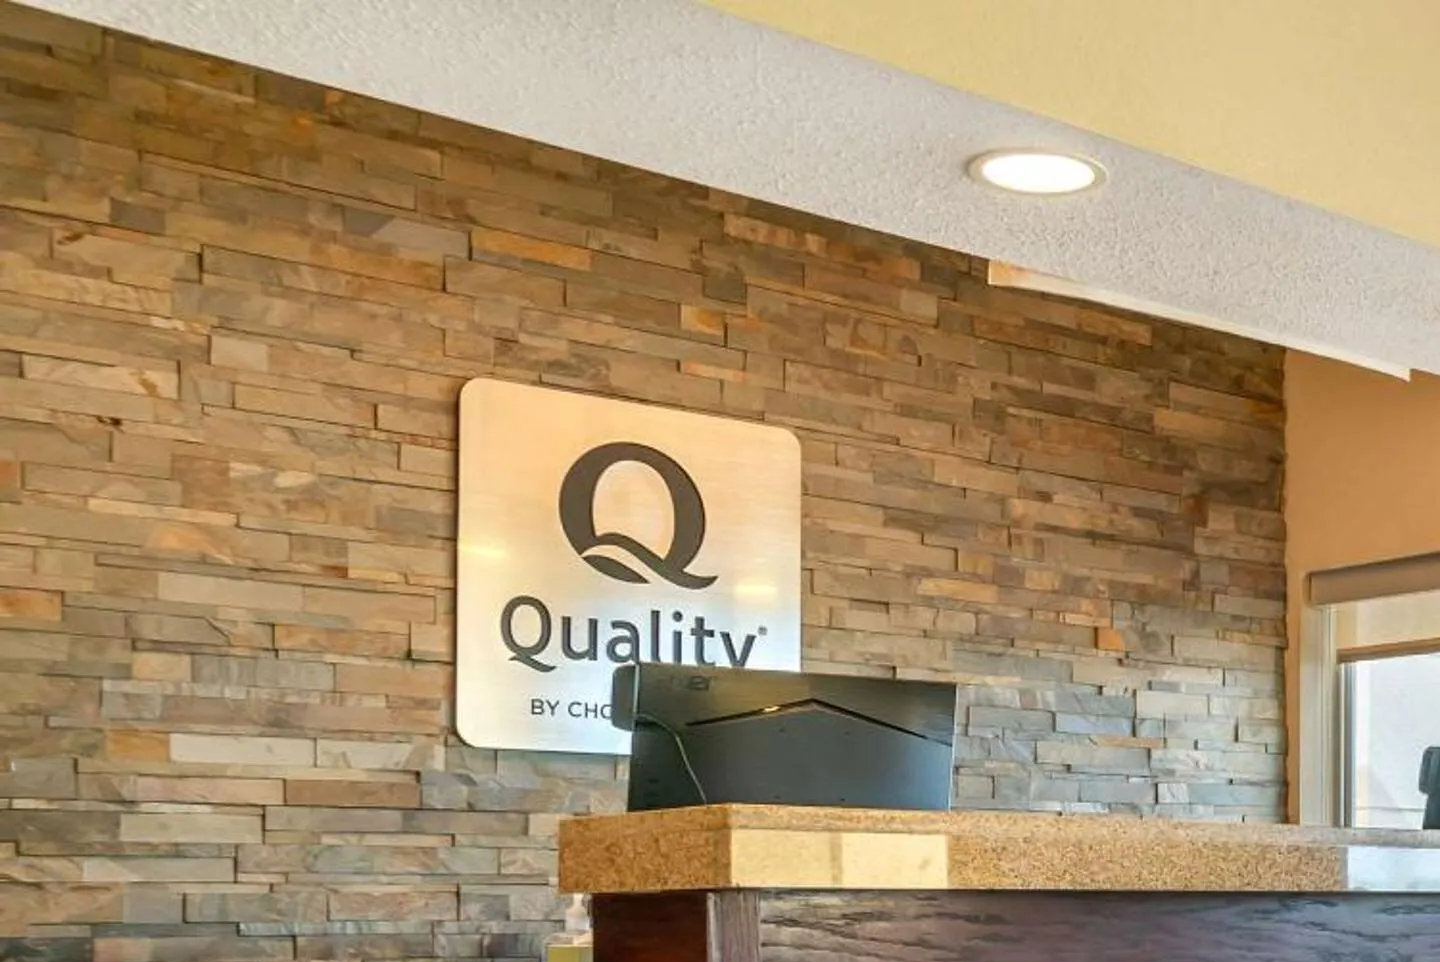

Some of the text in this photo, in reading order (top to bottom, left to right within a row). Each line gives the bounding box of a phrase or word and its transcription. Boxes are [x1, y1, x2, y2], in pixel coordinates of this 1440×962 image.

[559, 441, 718, 589] Q
[500, 595, 757, 673] Quality
[531, 699, 612, 719] BY CHO
